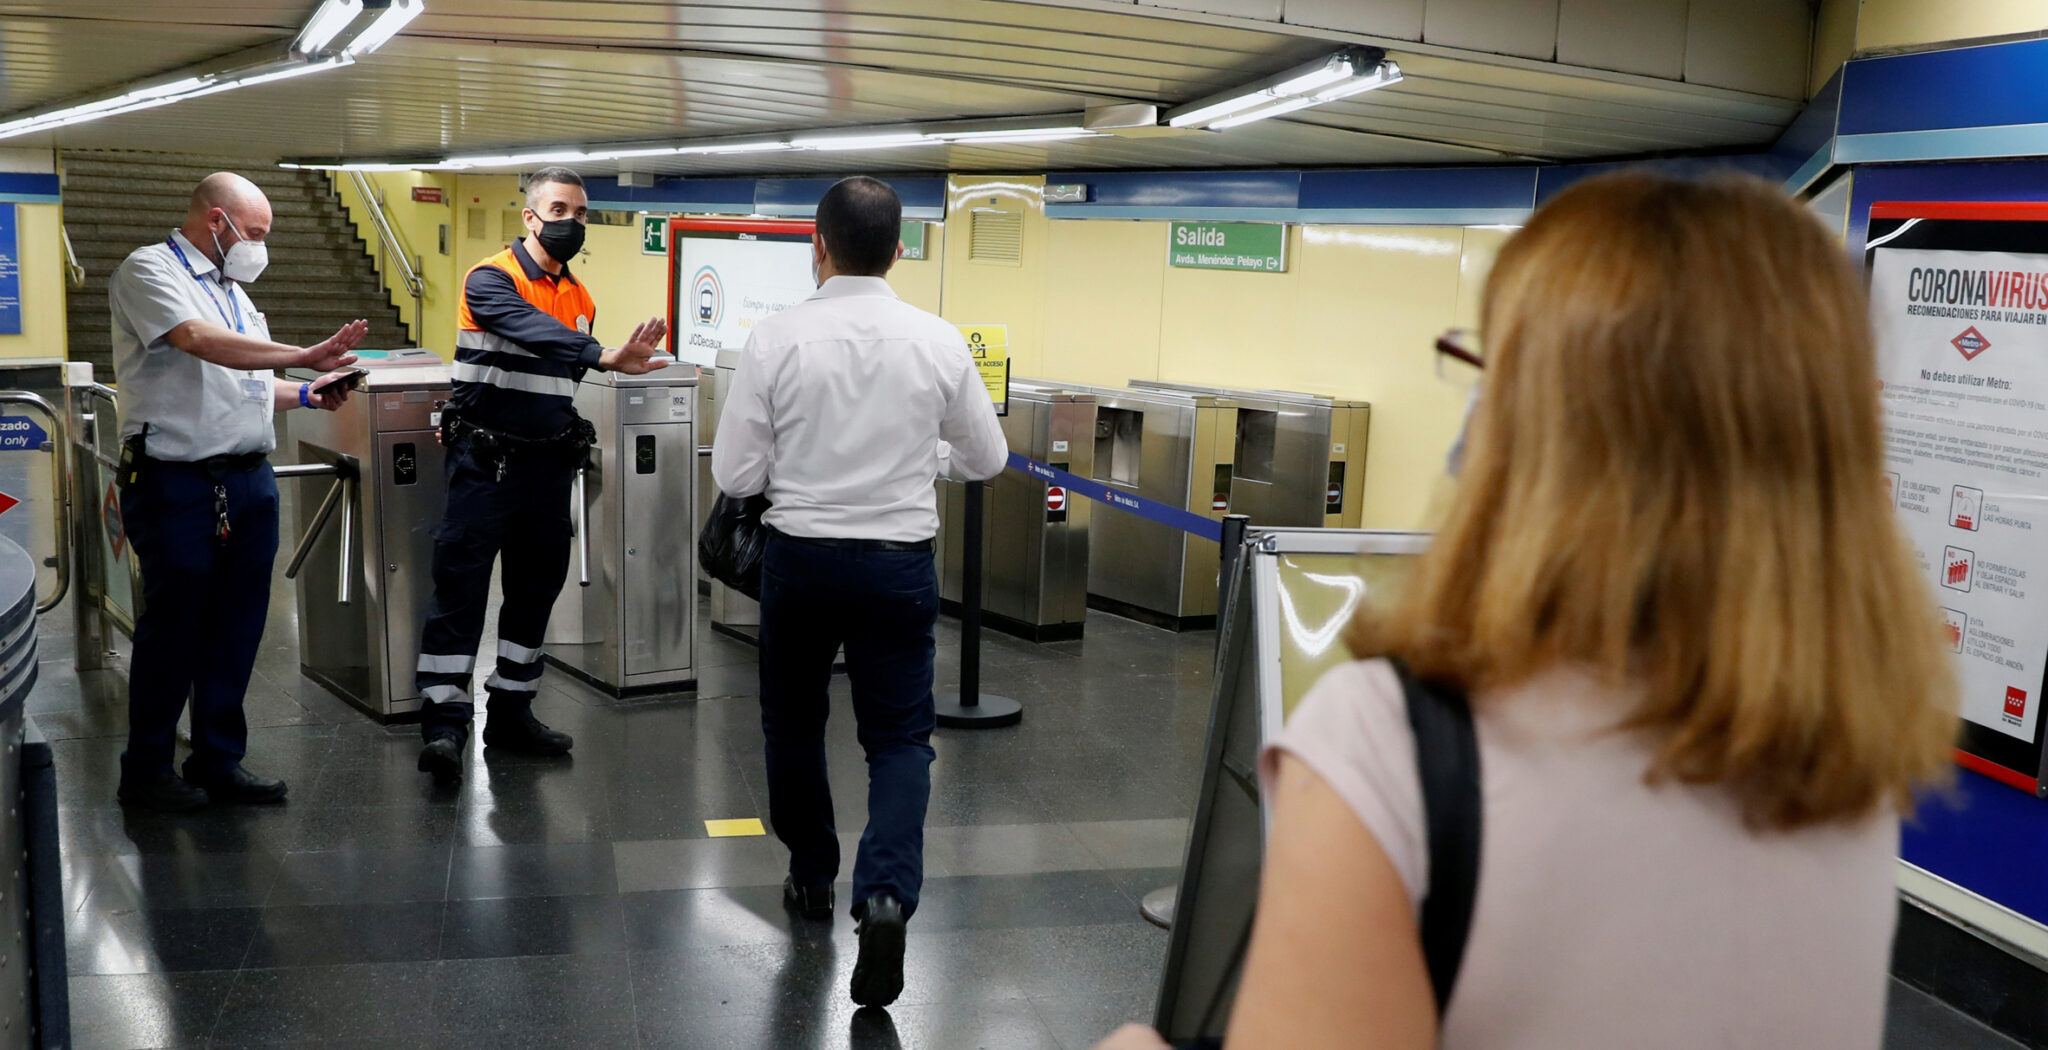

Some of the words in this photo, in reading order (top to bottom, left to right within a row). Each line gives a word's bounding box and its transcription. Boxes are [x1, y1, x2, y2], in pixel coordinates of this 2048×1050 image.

[1177, 226, 1225, 246] Salida
[1175, 254, 1196, 265] Avda.
[1198, 254, 1235, 266] Menéndez
[1237, 256, 1263, 269] Pelayo
[1907, 304, 1979, 321] RECOMENDACIONES
[1980, 310, 2002, 322] PARA
[2004, 312, 2035, 325] VIAJAR
[2036, 314, 2047, 325] EN
[689, 332, 722, 349] JCDecaux
[1962, 339, 1980, 349] Metro
[1921, 369, 1931, 381] No
[1933, 371, 1956, 384] debes
[1958, 374, 1985, 386] utilizar
[1986, 376, 2013, 391] Metro:
[5, 436, 29, 448] only
